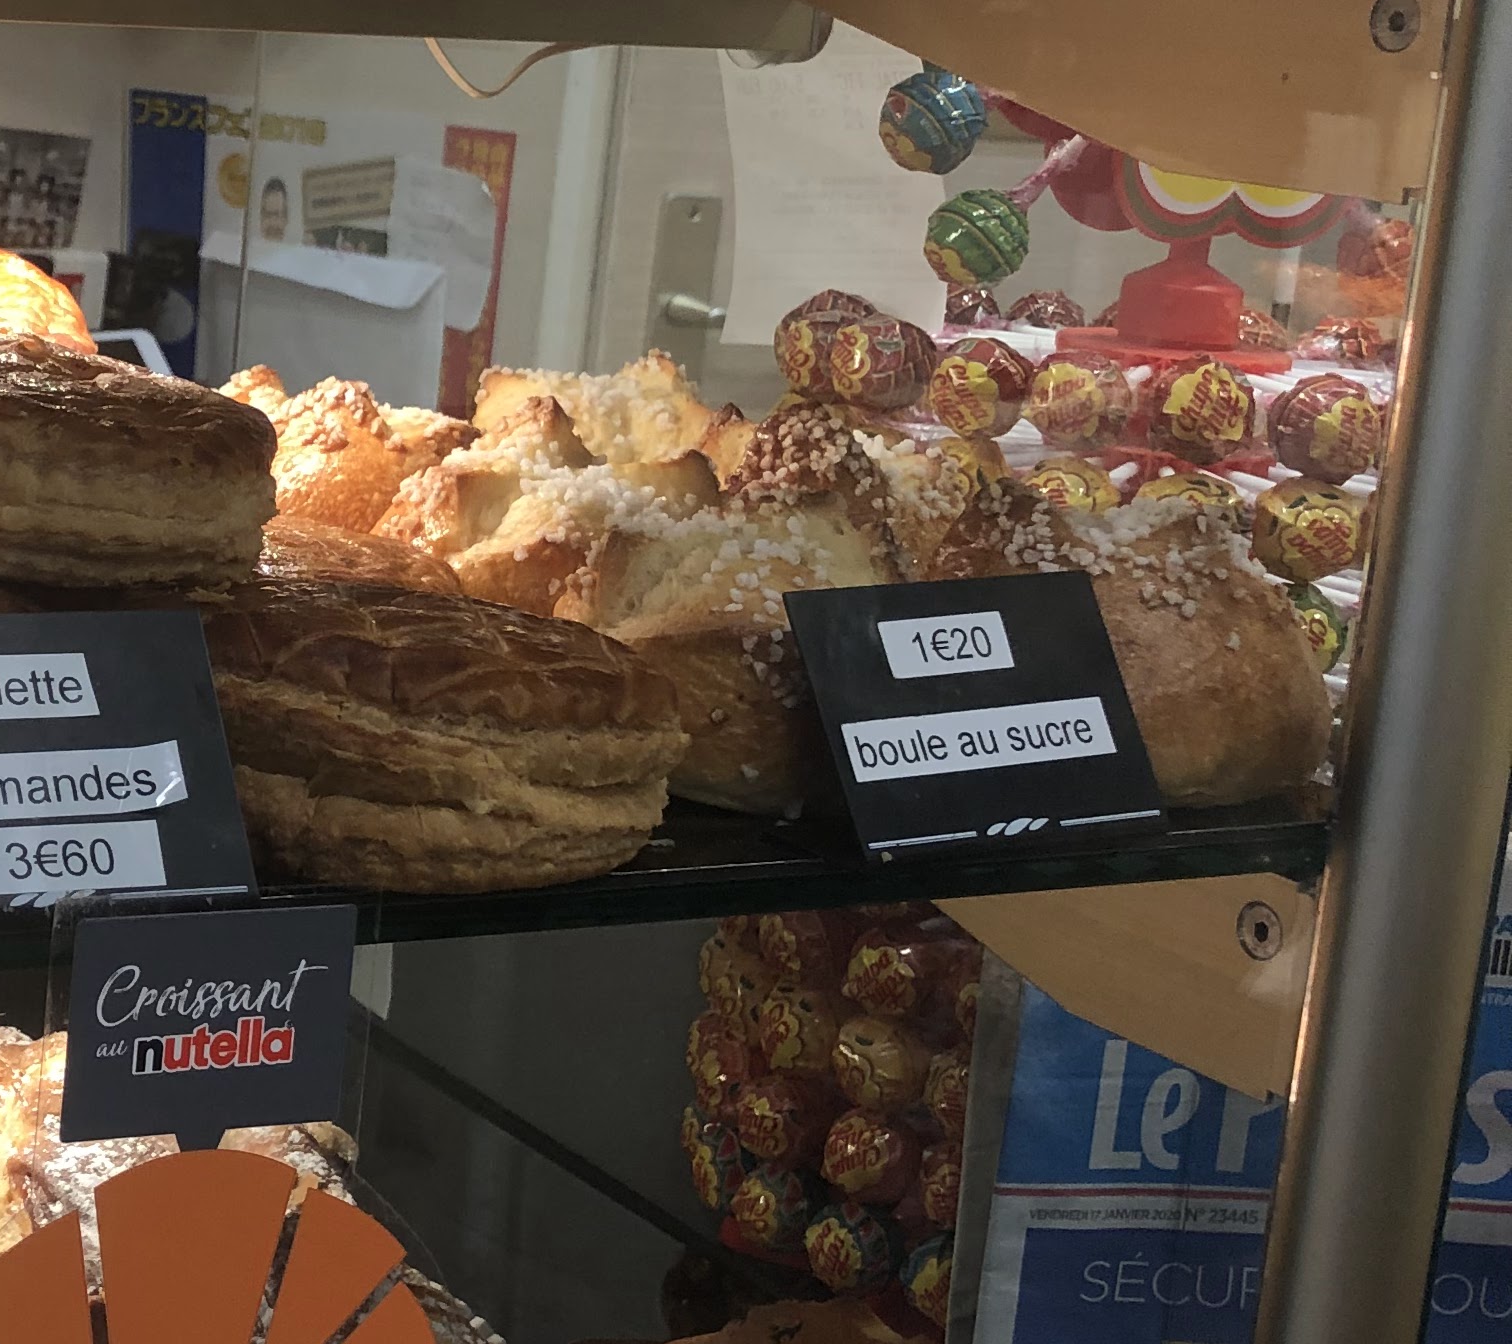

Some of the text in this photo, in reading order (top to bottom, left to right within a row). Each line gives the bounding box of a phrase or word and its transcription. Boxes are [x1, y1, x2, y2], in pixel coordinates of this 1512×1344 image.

[911, 627, 993, 664] 1€20
[854, 716, 1093, 768] boule au sucre
[5, 838, 115, 880] 3€60
[96, 959, 329, 1028] Croissant
[95, 1016, 296, 1075] au nutella
[1087, 1040, 1199, 1172] Le
[1029, 1208, 1088, 1222] VENDREDI
[1102, 1209, 1149, 1222] JANVIER
[1151, 1209, 1181, 1222] 2020
[1185, 1209, 1207, 1223] N°
[1209, 1210, 1259, 1225] 23445
